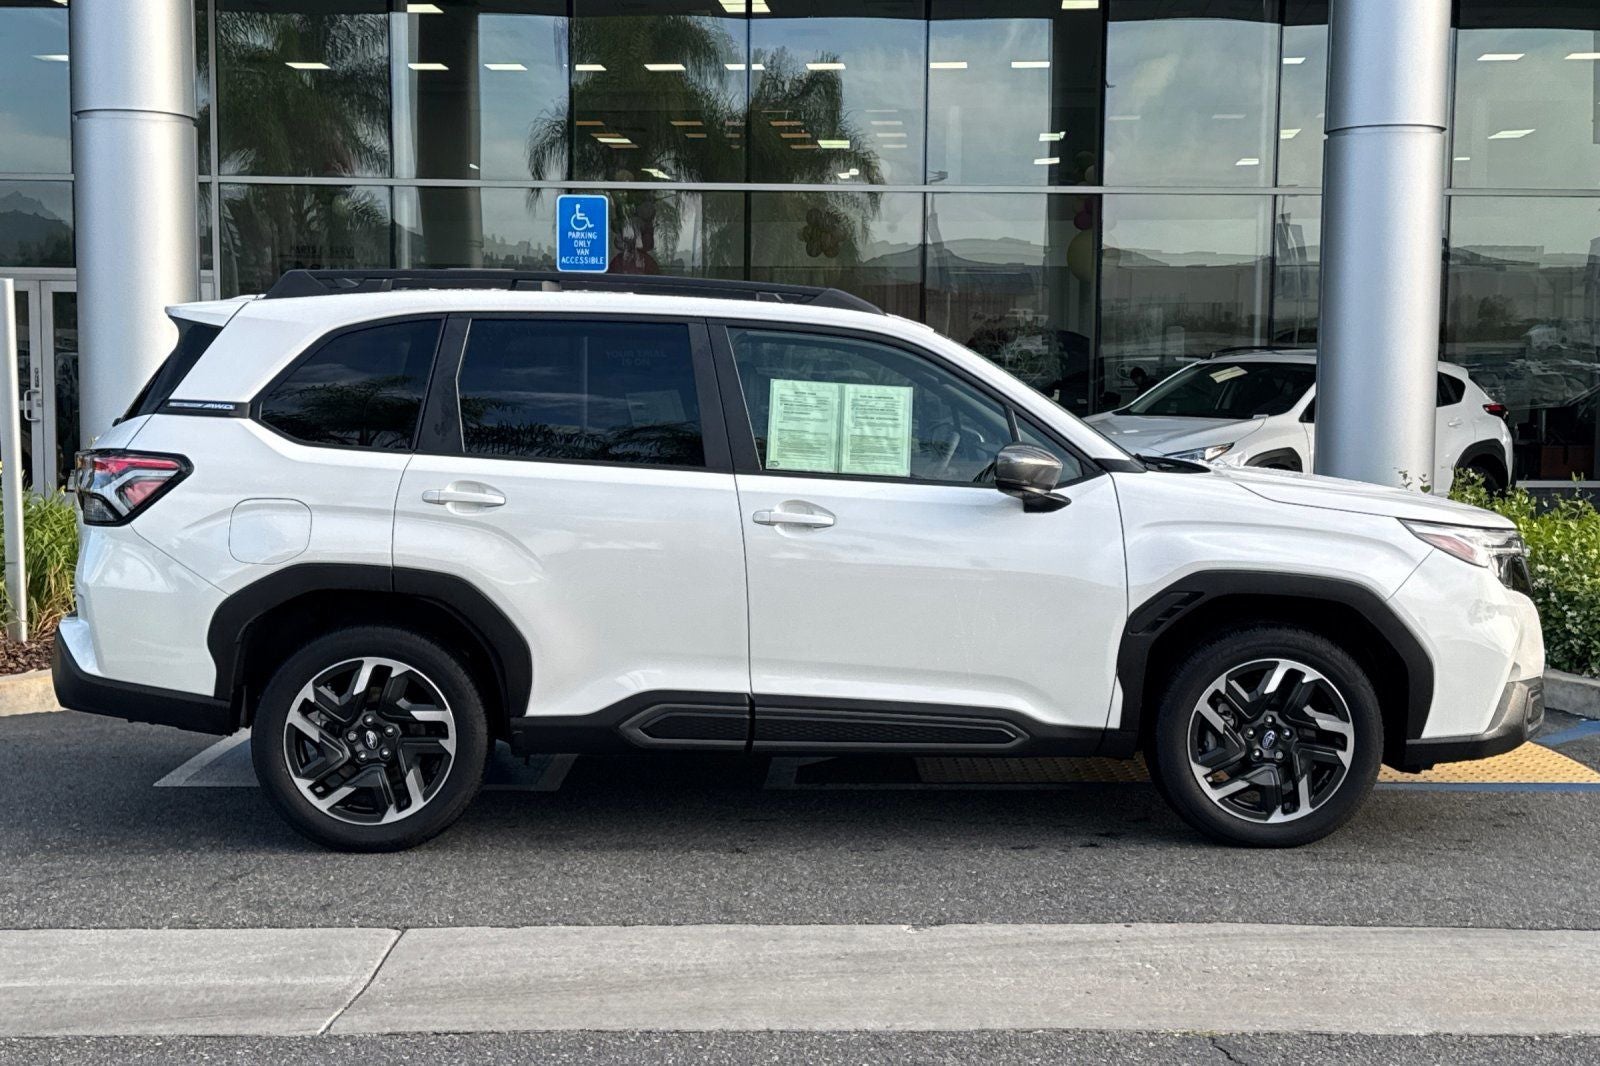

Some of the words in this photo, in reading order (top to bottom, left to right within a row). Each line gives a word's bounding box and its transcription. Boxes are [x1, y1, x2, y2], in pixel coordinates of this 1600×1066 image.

[567, 231, 598, 239] PARKING
[573, 239, 592, 248] ONLY
[576, 248, 590, 256] VAN
[561, 256, 605, 265] ACCESSIBLE
